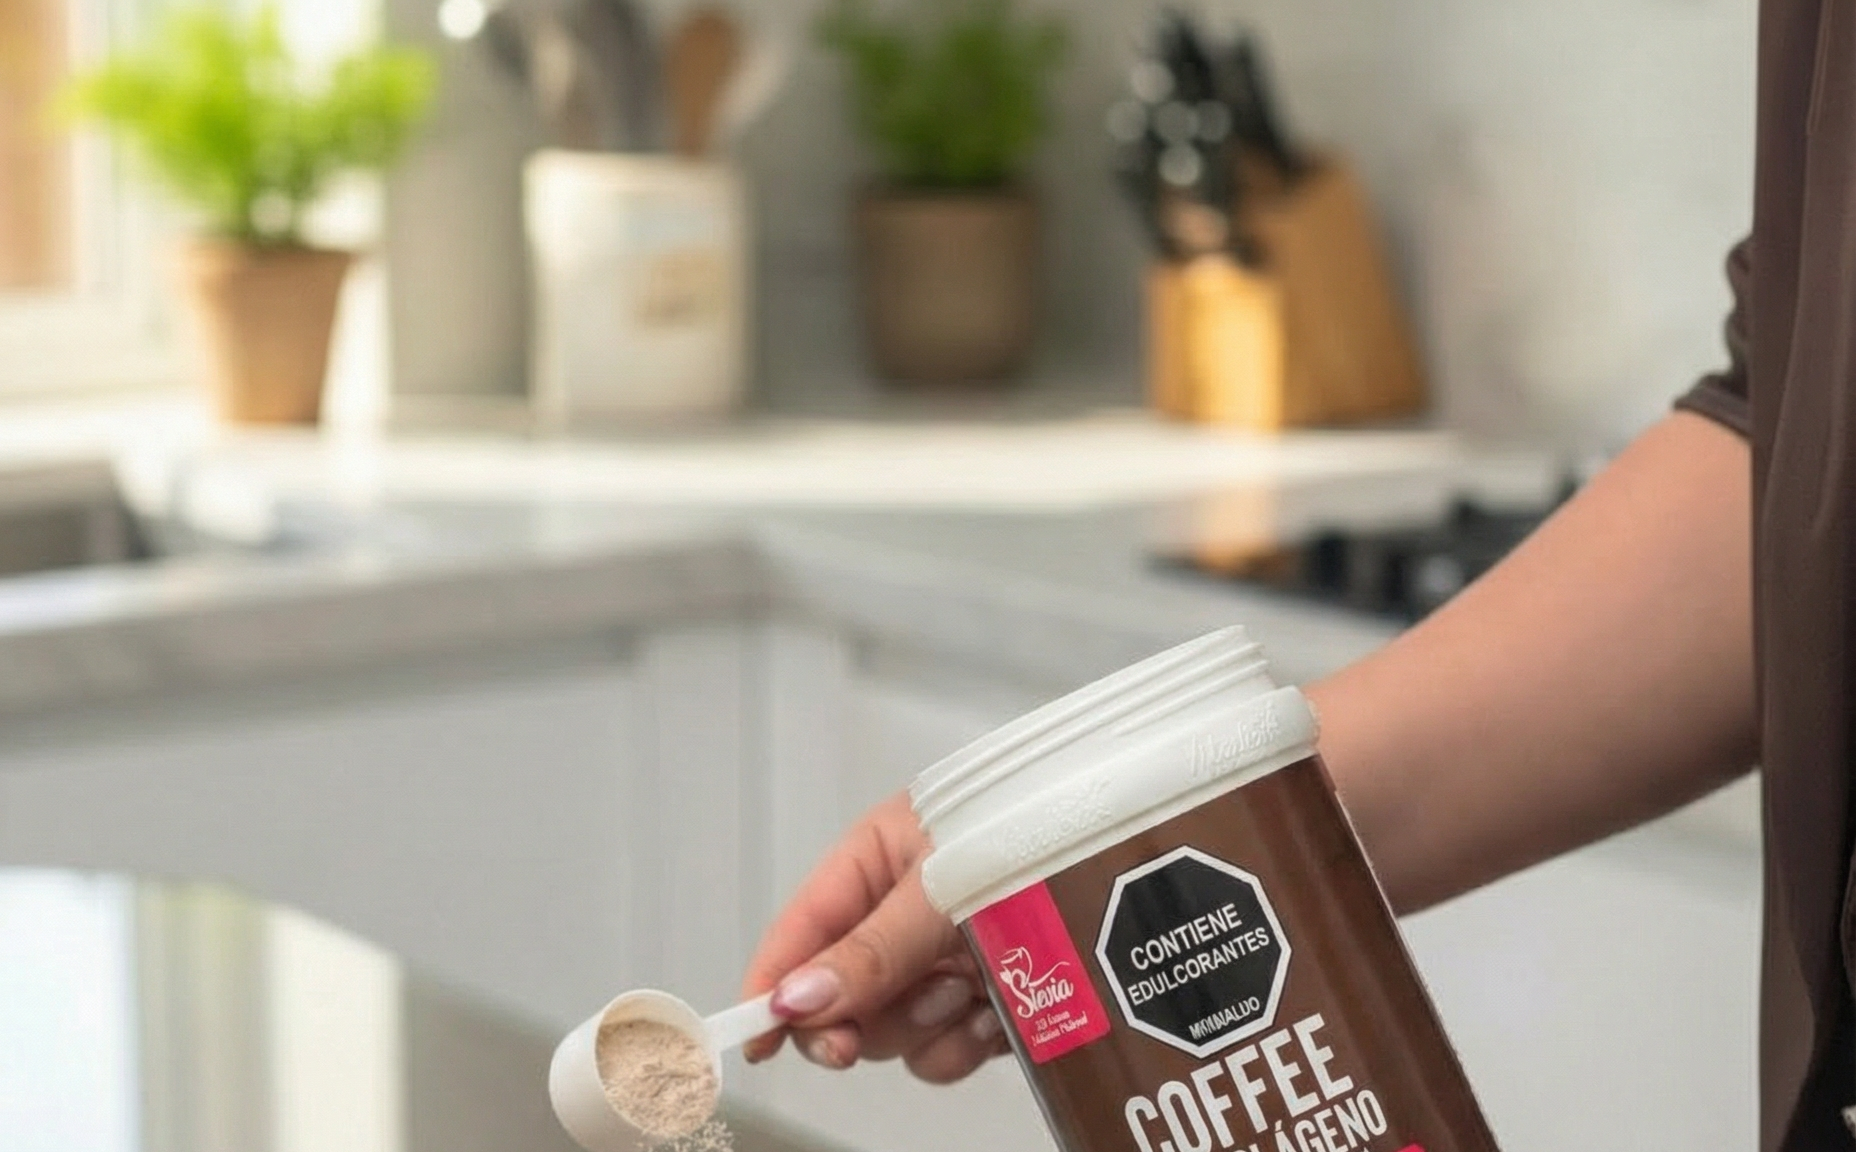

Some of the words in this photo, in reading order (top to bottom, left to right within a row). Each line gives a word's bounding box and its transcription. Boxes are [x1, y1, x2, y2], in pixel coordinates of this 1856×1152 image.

[1127, 927, 1270, 1006] EDULCORANTES
[1130, 903, 1243, 971] CONTIENE
[1000, 967, 1075, 1018] Stevia
